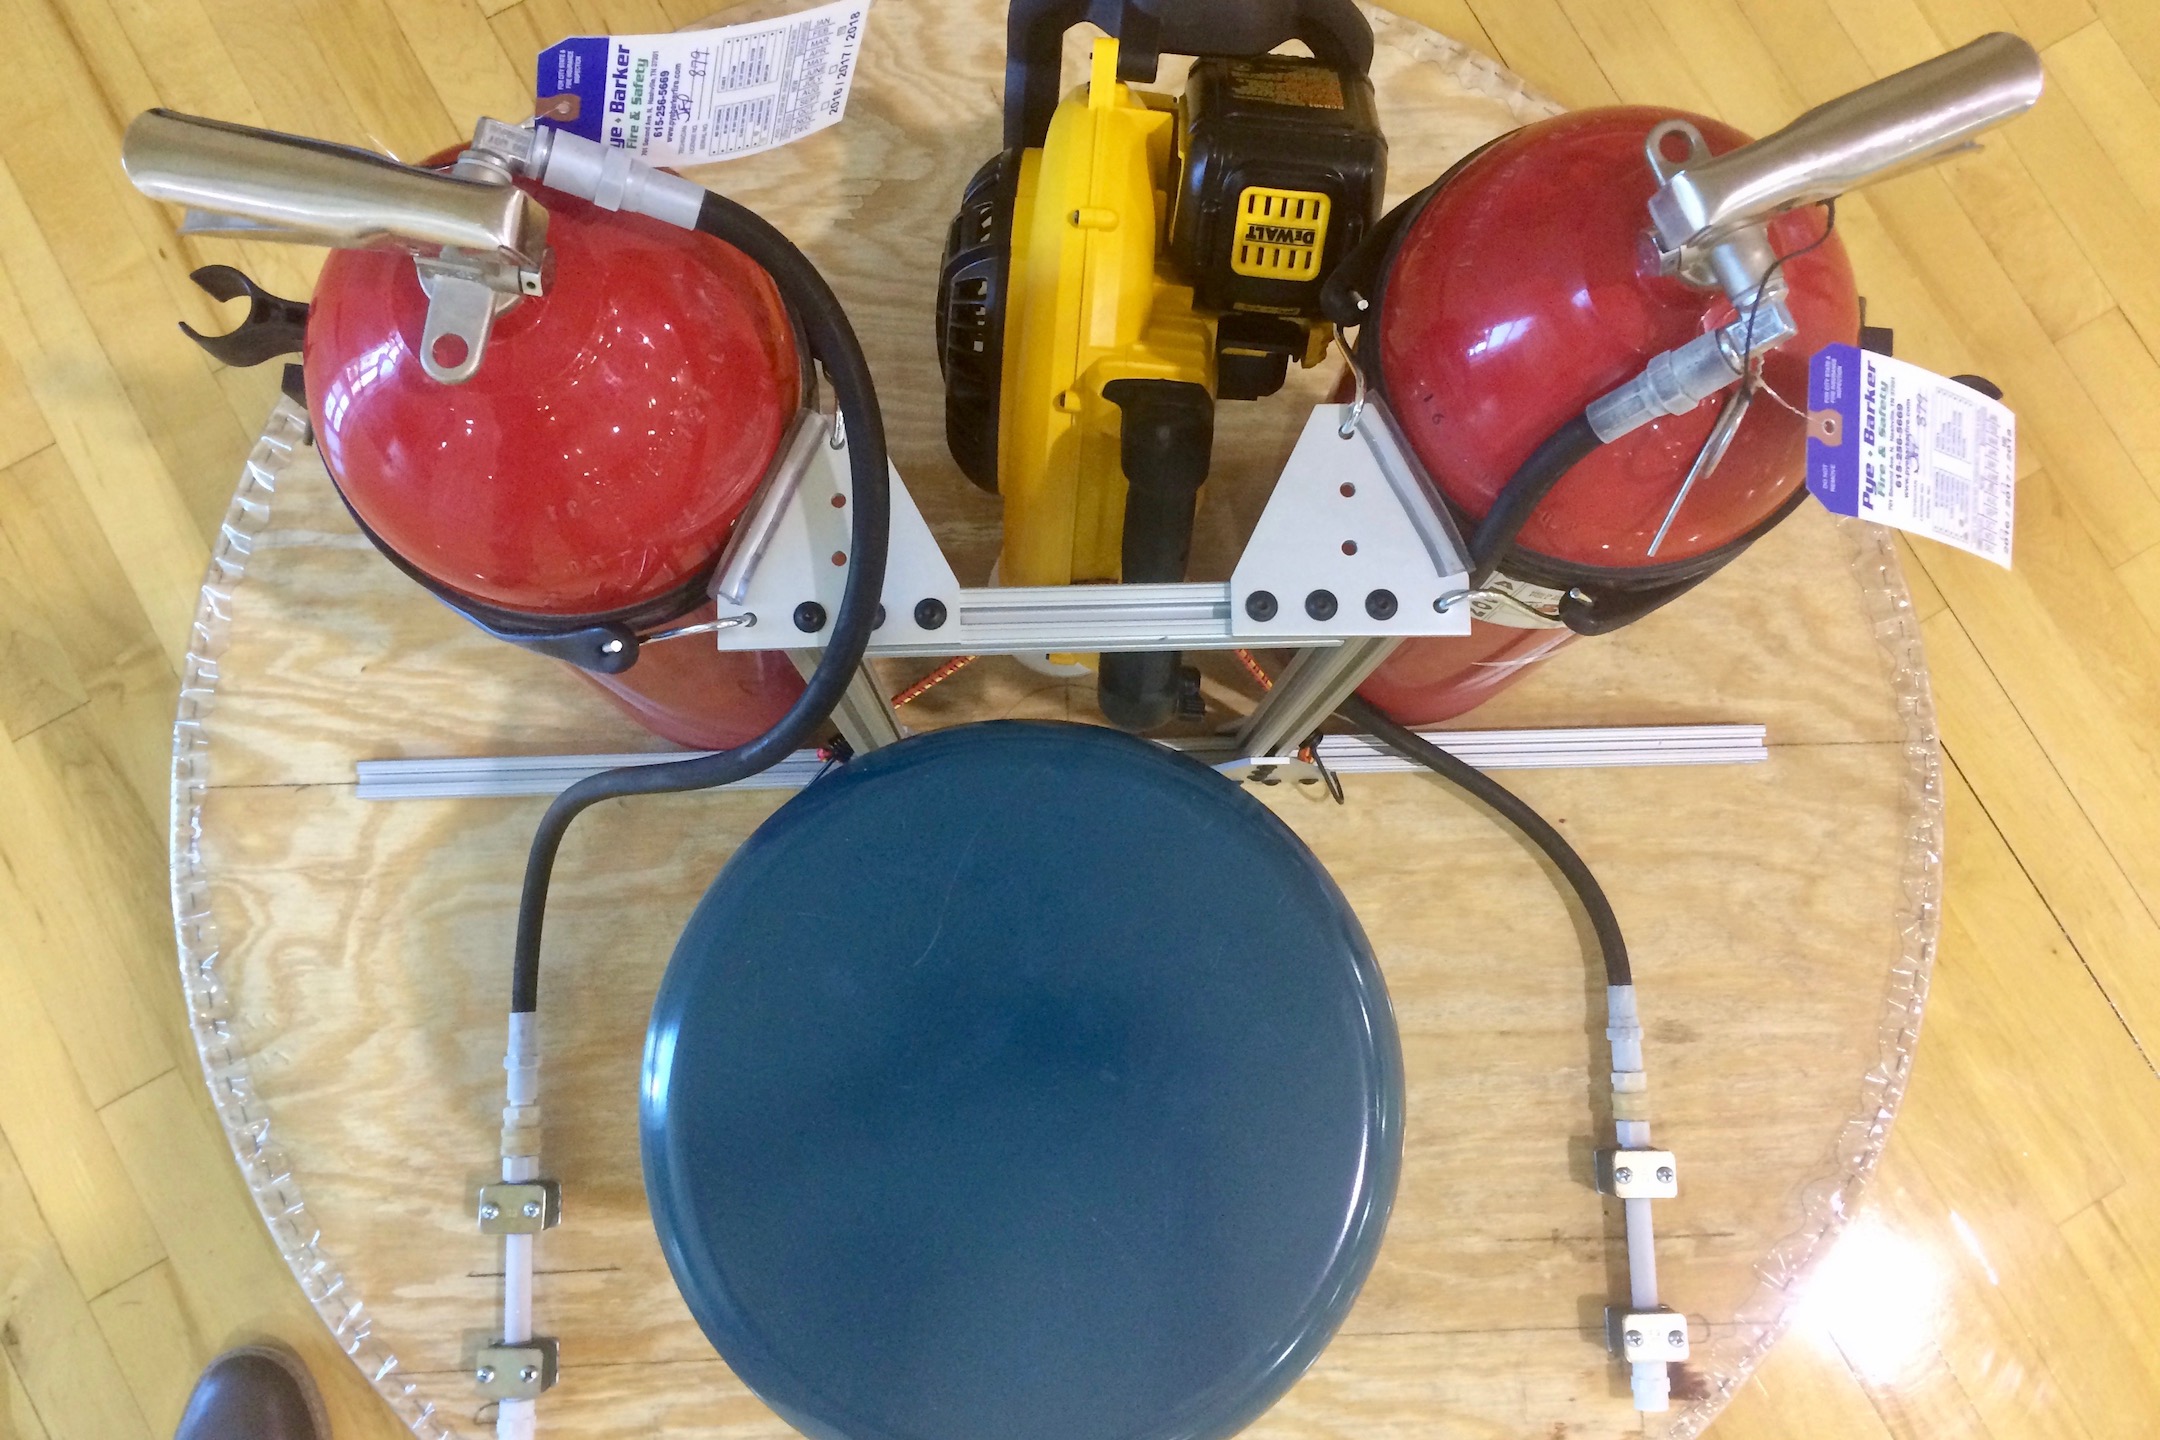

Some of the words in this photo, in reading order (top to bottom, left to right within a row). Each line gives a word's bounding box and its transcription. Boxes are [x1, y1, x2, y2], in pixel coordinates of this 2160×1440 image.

[610, 44, 630, 113] Barker
[632, 59, 648, 105] Safety
[829, 88, 842, 115] 2016
[837, 53, 851, 79] 2017
[846, 11, 860, 41] 2018
[630, 111, 640, 120] &
[653, 70, 669, 137] 615-256-5669
[666, 63, 681, 142] www.pyebarkerfire.com
[610, 127, 625, 148] ye
[627, 125, 639, 149] Fire
[1863, 360, 1876, 446] Barker
[1878, 380, 1888, 438] Safety
[1878, 446, 1886, 458] &
[1823, 479, 1828, 489] DO
[1863, 463, 1876, 510] Pye
[1877, 464, 1886, 497] Fire
